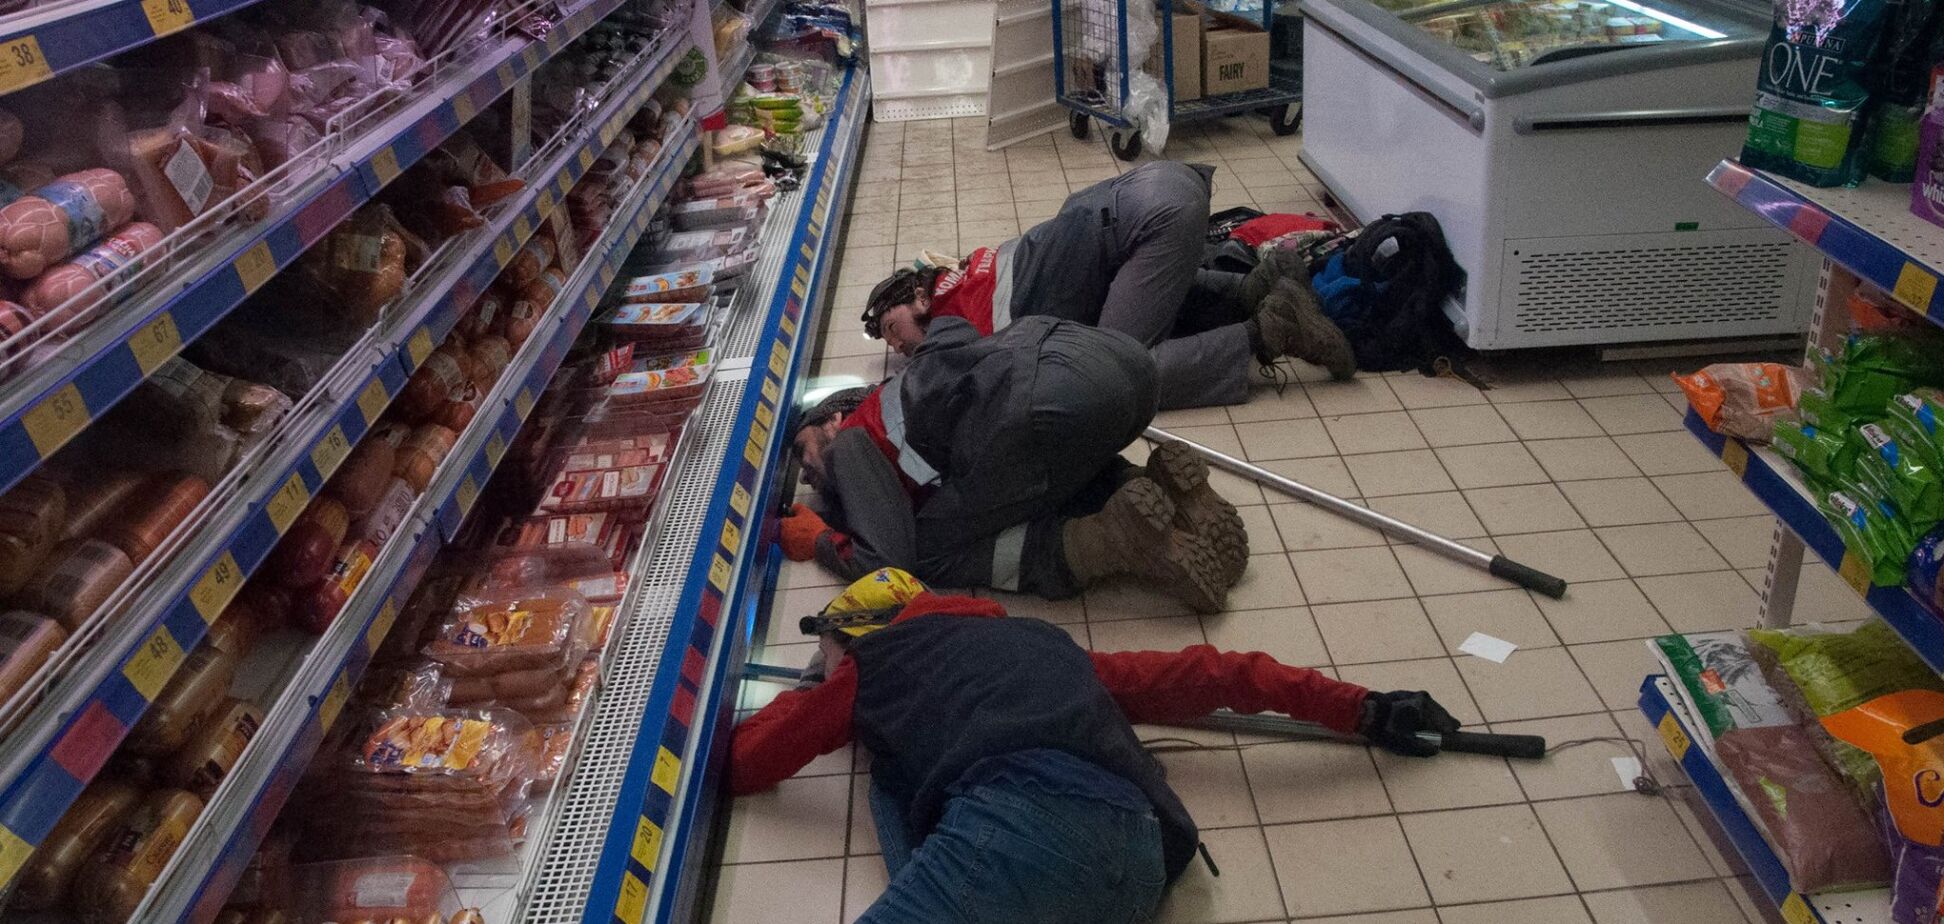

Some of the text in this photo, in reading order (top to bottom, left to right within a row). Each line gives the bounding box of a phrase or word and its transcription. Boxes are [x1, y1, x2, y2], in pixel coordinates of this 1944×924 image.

[168, 0, 182, 15] 40
[1801, 34, 1840, 51] PUNA
[12, 43, 34, 67] 38
[1219, 62, 1245, 81] FAIRY
[1769, 42, 1839, 96] ONE
[153, 320, 169, 343] 67
[215, 563, 230, 584] 49
[150, 636, 169, 660] 48
[1673, 730, 1685, 748] 25
[640, 826, 653, 845] 20
